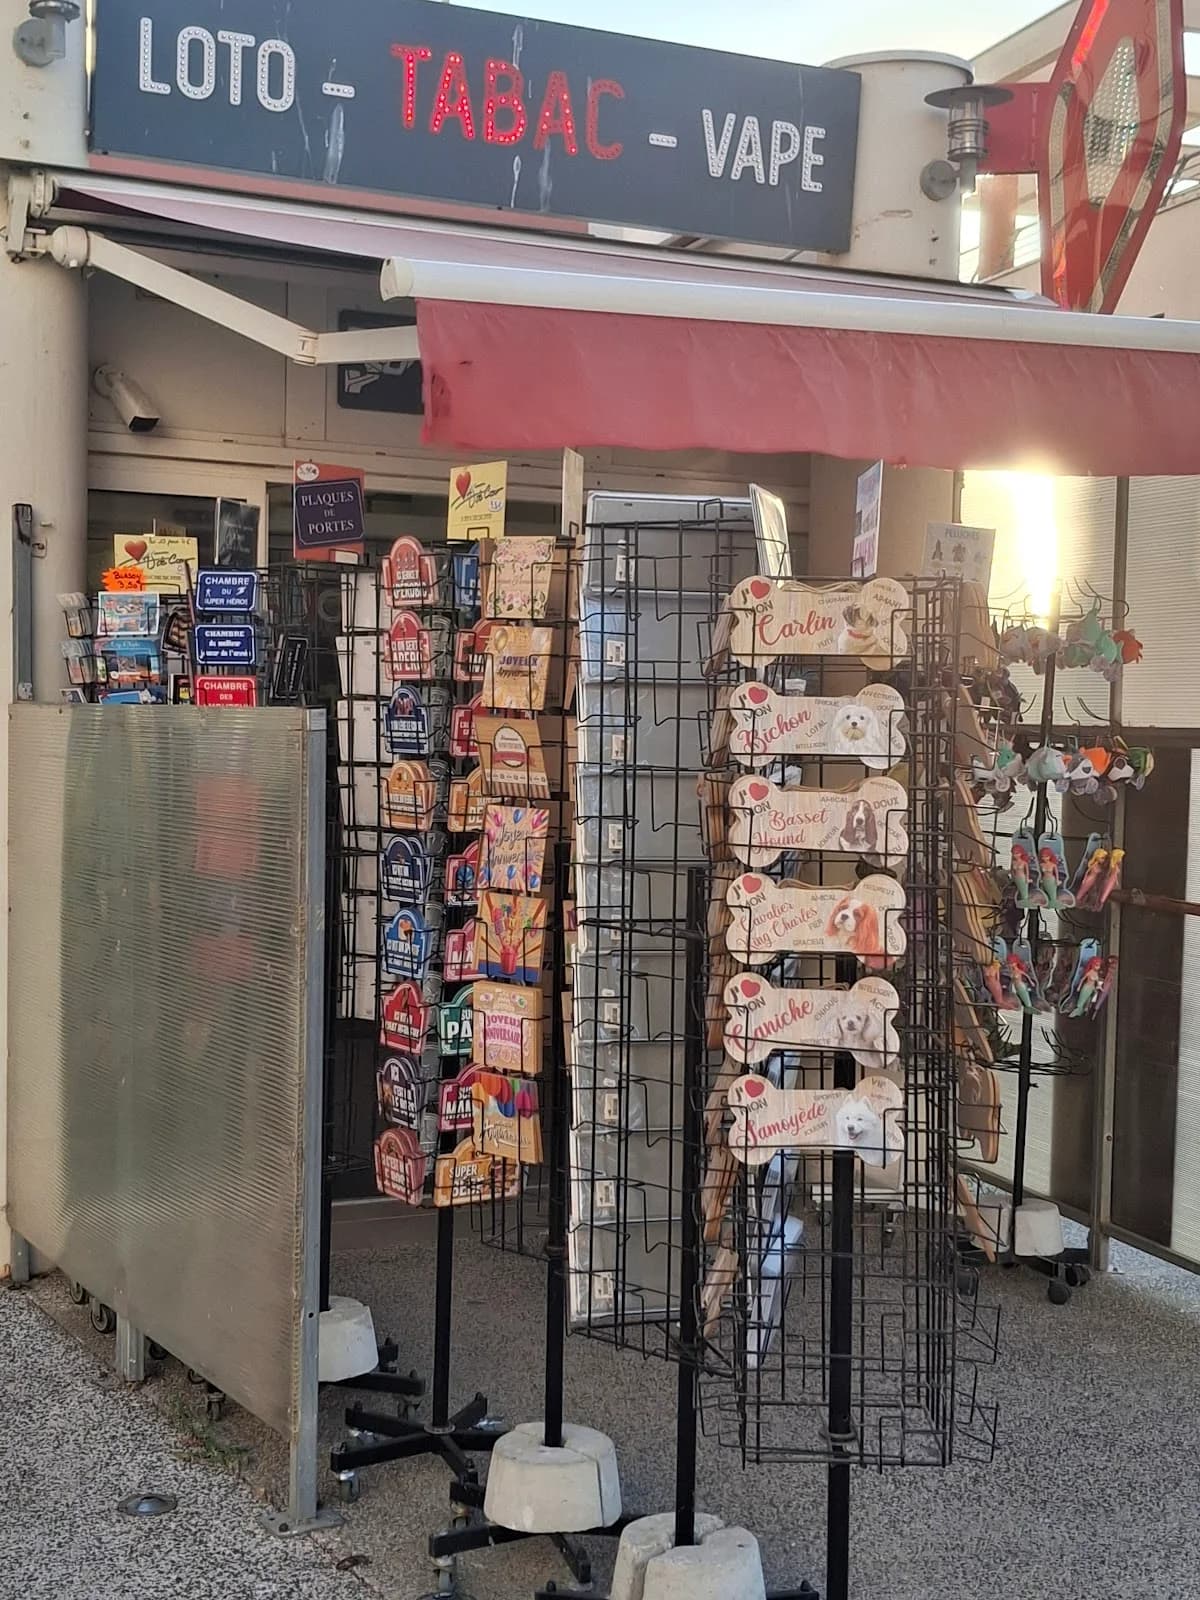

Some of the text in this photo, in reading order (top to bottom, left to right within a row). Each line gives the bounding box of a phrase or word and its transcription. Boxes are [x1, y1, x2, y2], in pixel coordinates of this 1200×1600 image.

[140, 17, 296, 113] LOTO
[391, 43, 625, 161] TABAC
[701, 108, 827, 193] VAPE
[301, 491, 354, 507] PLAQUES
[323, 509, 336, 518] DE
[308, 519, 355, 535] PORTES
[204, 577, 250, 586] CHAMBRE
[741, 588, 750, 604] J'
[744, 599, 774, 619] MON
[204, 630, 246, 638] CHAMBRE
[756, 610, 837, 646] Carlin
[203, 682, 249, 690] CHAMBRE
[738, 693, 747, 708] J'
[742, 704, 773, 722] MON
[736, 709, 812, 755] Bichon
[805, 720, 828, 738] LOYAL
[738, 789, 747, 805] J'
[873, 796, 900, 810] DOUX
[742, 800, 772, 818] MON
[768, 808, 830, 832] Basset
[751, 829, 807, 855] Hound
[732, 884, 742, 899] J'
[740, 901, 795, 933] Cavalier
[771, 905, 819, 937] Charles
[729, 985, 740, 1003] J'
[735, 995, 767, 1017] MON
[869, 997, 888, 1013] ACT
[727, 998, 815, 1051] Caniche
[734, 1086, 744, 1102] J'
[739, 1097, 769, 1116] MON
[735, 1102, 828, 1150] Samoyède
[449, 1164, 478, 1179] SUPER
